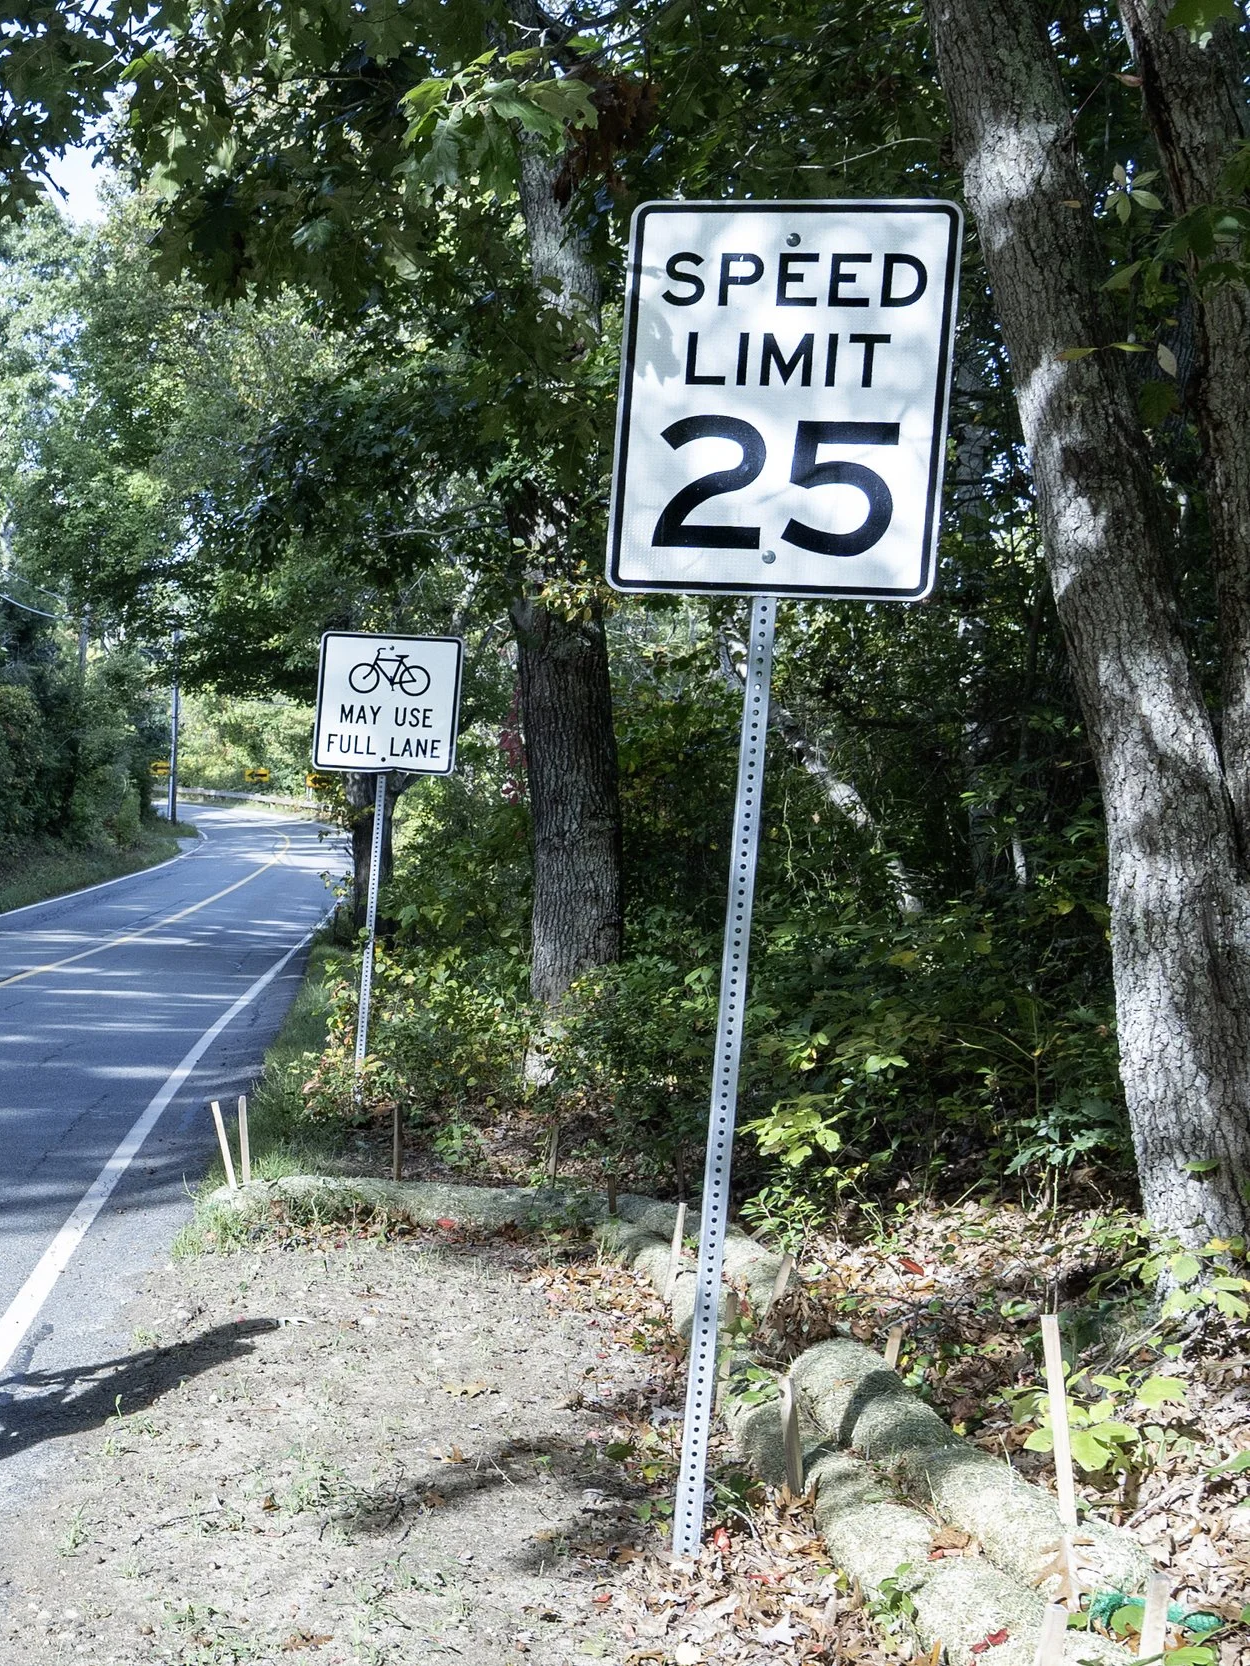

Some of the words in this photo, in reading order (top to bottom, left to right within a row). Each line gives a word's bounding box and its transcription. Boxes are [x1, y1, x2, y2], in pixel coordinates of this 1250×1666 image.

[661, 251, 928, 308] SPEED
[685, 331, 892, 388] LIMIT
[651, 414, 900, 557] 25
[339, 703, 382, 724] MAY
[394, 707, 433, 728] USE
[327, 733, 376, 755] FULL
[390, 737, 441, 759] LANE
